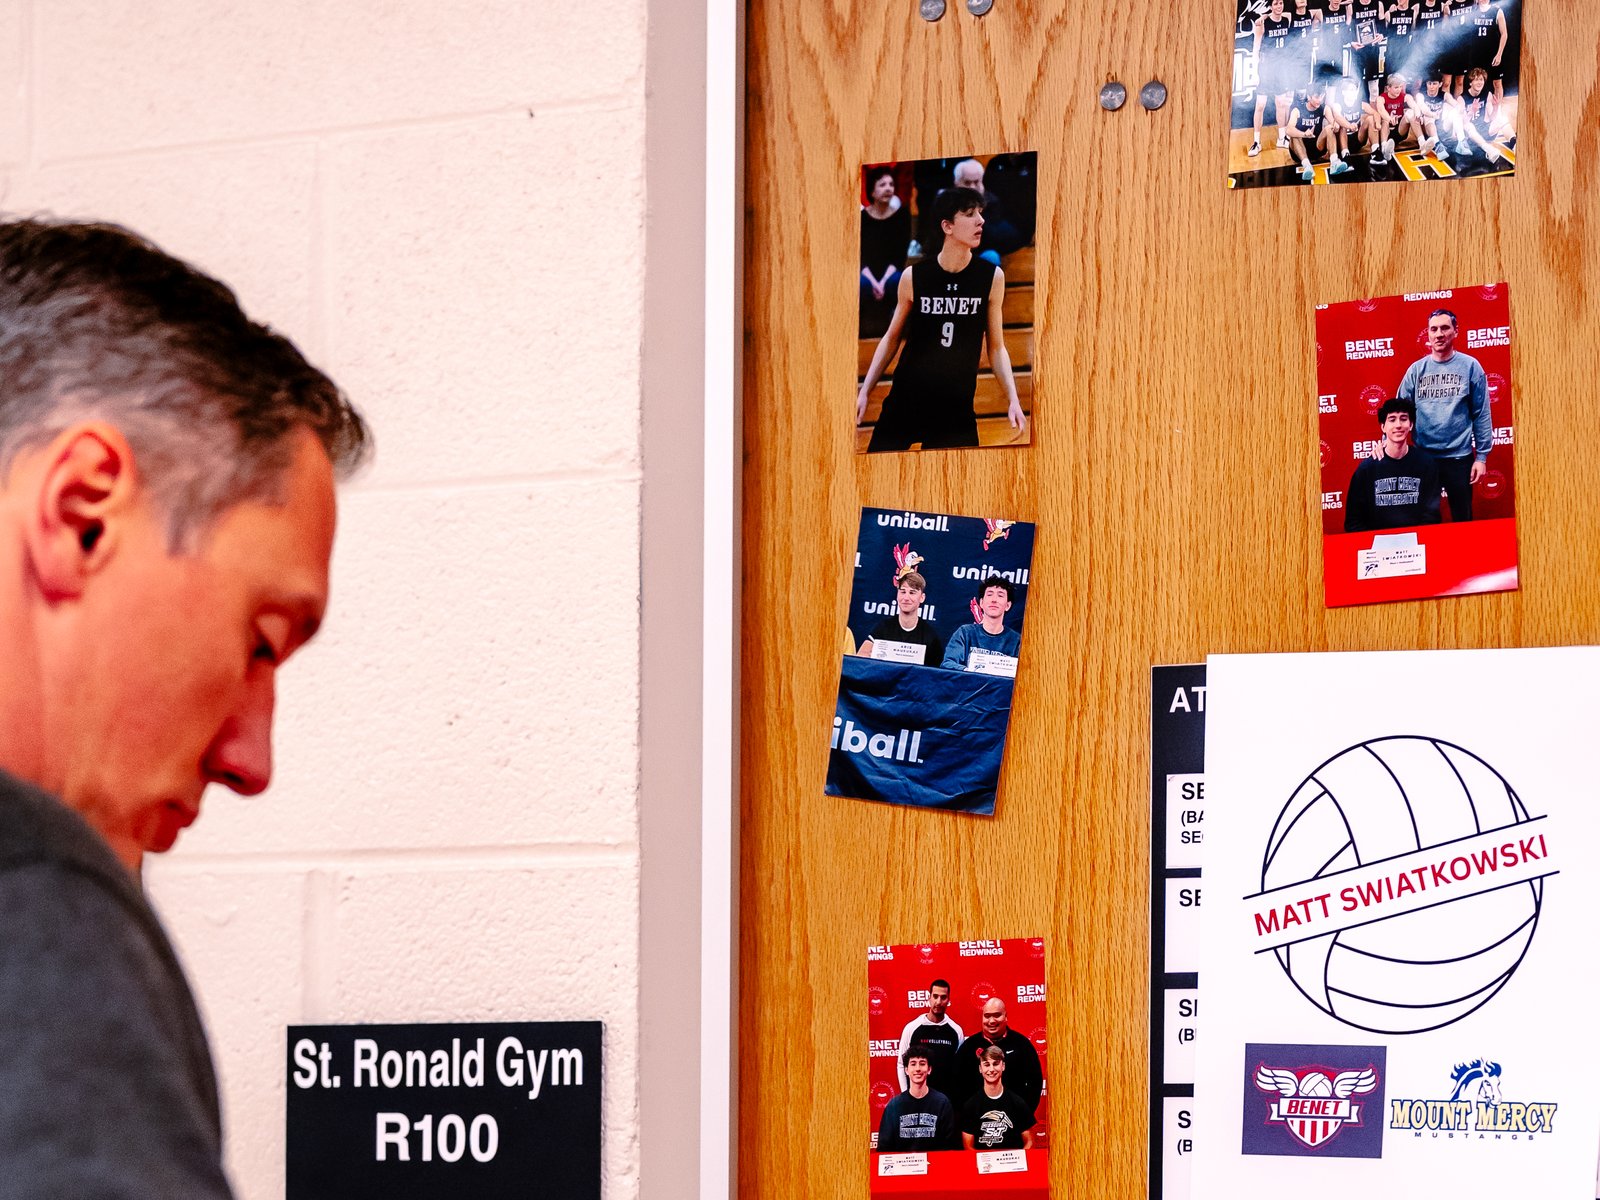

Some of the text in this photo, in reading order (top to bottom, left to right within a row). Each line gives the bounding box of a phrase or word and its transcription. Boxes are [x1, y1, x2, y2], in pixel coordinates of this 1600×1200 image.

[1396, 25, 1407, 35] 22
[1478, 27, 1487, 36] 13
[1403, 290, 1453, 302] REDWINGS
[920, 296, 982, 315] BENET
[940, 321, 954, 348] 9
[1345, 337, 1393, 352] BENET
[1346, 348, 1394, 360] REDWINGS
[1417, 373, 1462, 388] MOUNT MERCY
[1417, 387, 1461, 399] UNIVERSITY
[863, 600, 936, 621] unill
[1180, 830, 1204, 844] SE
[1254, 835, 1549, 937] MATT SWIATKOWSKI
[960, 948, 1003, 957] REDWINGS
[293, 1036, 583, 1100] St. Ronald Gym
[1287, 1100, 1342, 1115] BENET
[1390, 1099, 1558, 1133] MOUNT MERCY
[375, 1112, 499, 1163] R100
[1414, 1132, 1534, 1141] MUSTANGS
